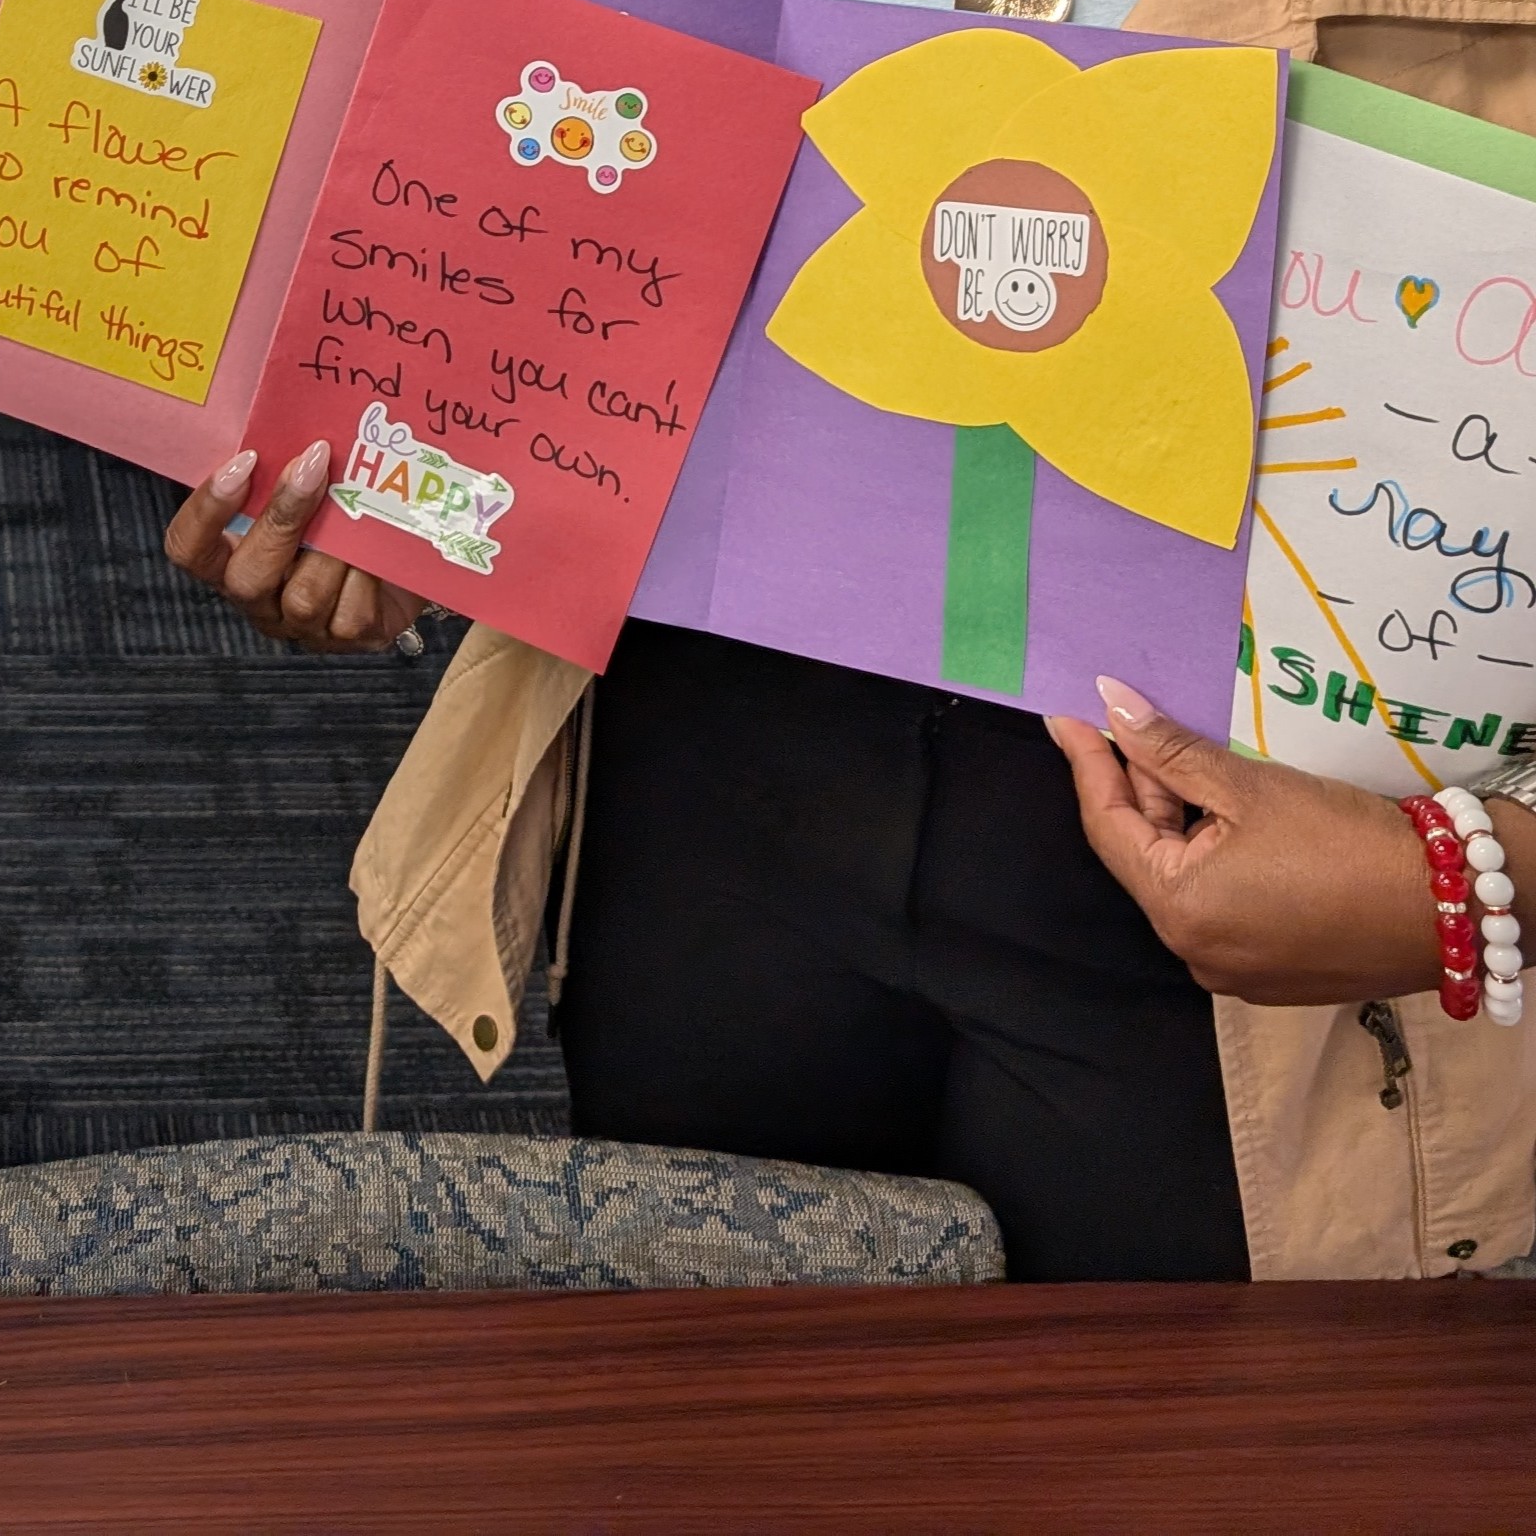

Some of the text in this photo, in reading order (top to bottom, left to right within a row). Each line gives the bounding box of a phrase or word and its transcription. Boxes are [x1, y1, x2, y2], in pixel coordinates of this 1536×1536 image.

[132, 21, 180, 58] YOUR
[559, 86, 610, 121] Smile
[53, 176, 209, 240] remind
[371, 159, 458, 218] One
[571, 237, 683, 307] my
[94, 236, 166, 277] of
[940, 209, 1084, 270] DON'T WORRY
[549, 287, 639, 340] for
[963, 267, 985, 317] BE
[100, 305, 205, 381] things.
[299, 335, 631, 503] find your own.
[490, 349, 568, 404] you
[588, 379, 687, 437] can't
[363, 406, 417, 457] be
[349, 443, 505, 536] HAPPY
[1329, 480, 1536, 614] ray
